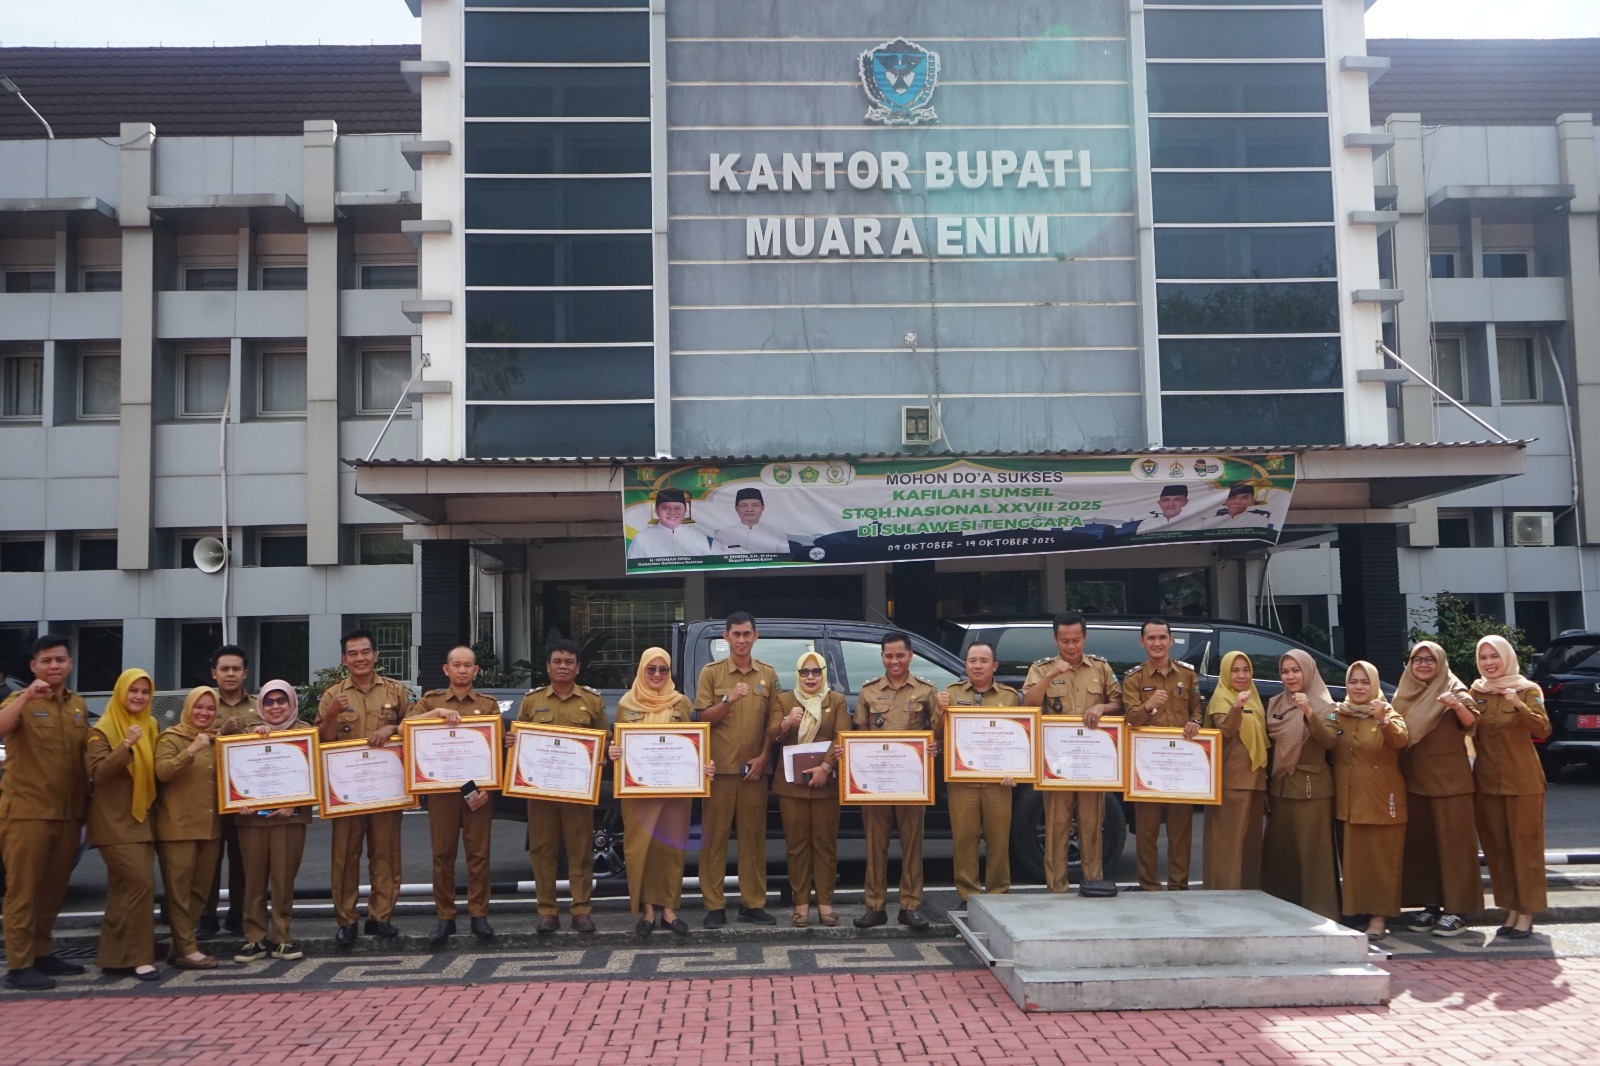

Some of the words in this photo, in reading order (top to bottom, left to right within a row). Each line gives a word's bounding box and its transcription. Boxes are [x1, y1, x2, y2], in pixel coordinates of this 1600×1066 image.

[708, 150, 913, 192] KANTOR
[924, 149, 1093, 191] BUPATI
[745, 217, 924, 258] MUARA
[936, 215, 1051, 257] ENIM
[886, 472, 947, 486] MOHON
[997, 471, 1064, 484] SUKSES
[892, 487, 975, 502] KAFILAH
[979, 487, 1054, 499] SUMSEL
[841, 506, 892, 520] STQH
[896, 503, 991, 518] NASIONAL
[998, 501, 1054, 514] XXVIII
[1057, 500, 1102, 512] 2025
[857, 524, 878, 538] DI
[879, 518, 978, 536] SULAWESI
[980, 516, 1085, 531] TENGGARA
[887, 543, 900, 552] 09
[903, 540, 954, 551] OKTOBER
[965, 539, 976, 548] 19
[979, 537, 1029, 548] OKTOBER
[1032, 536, 1055, 545] 2025
